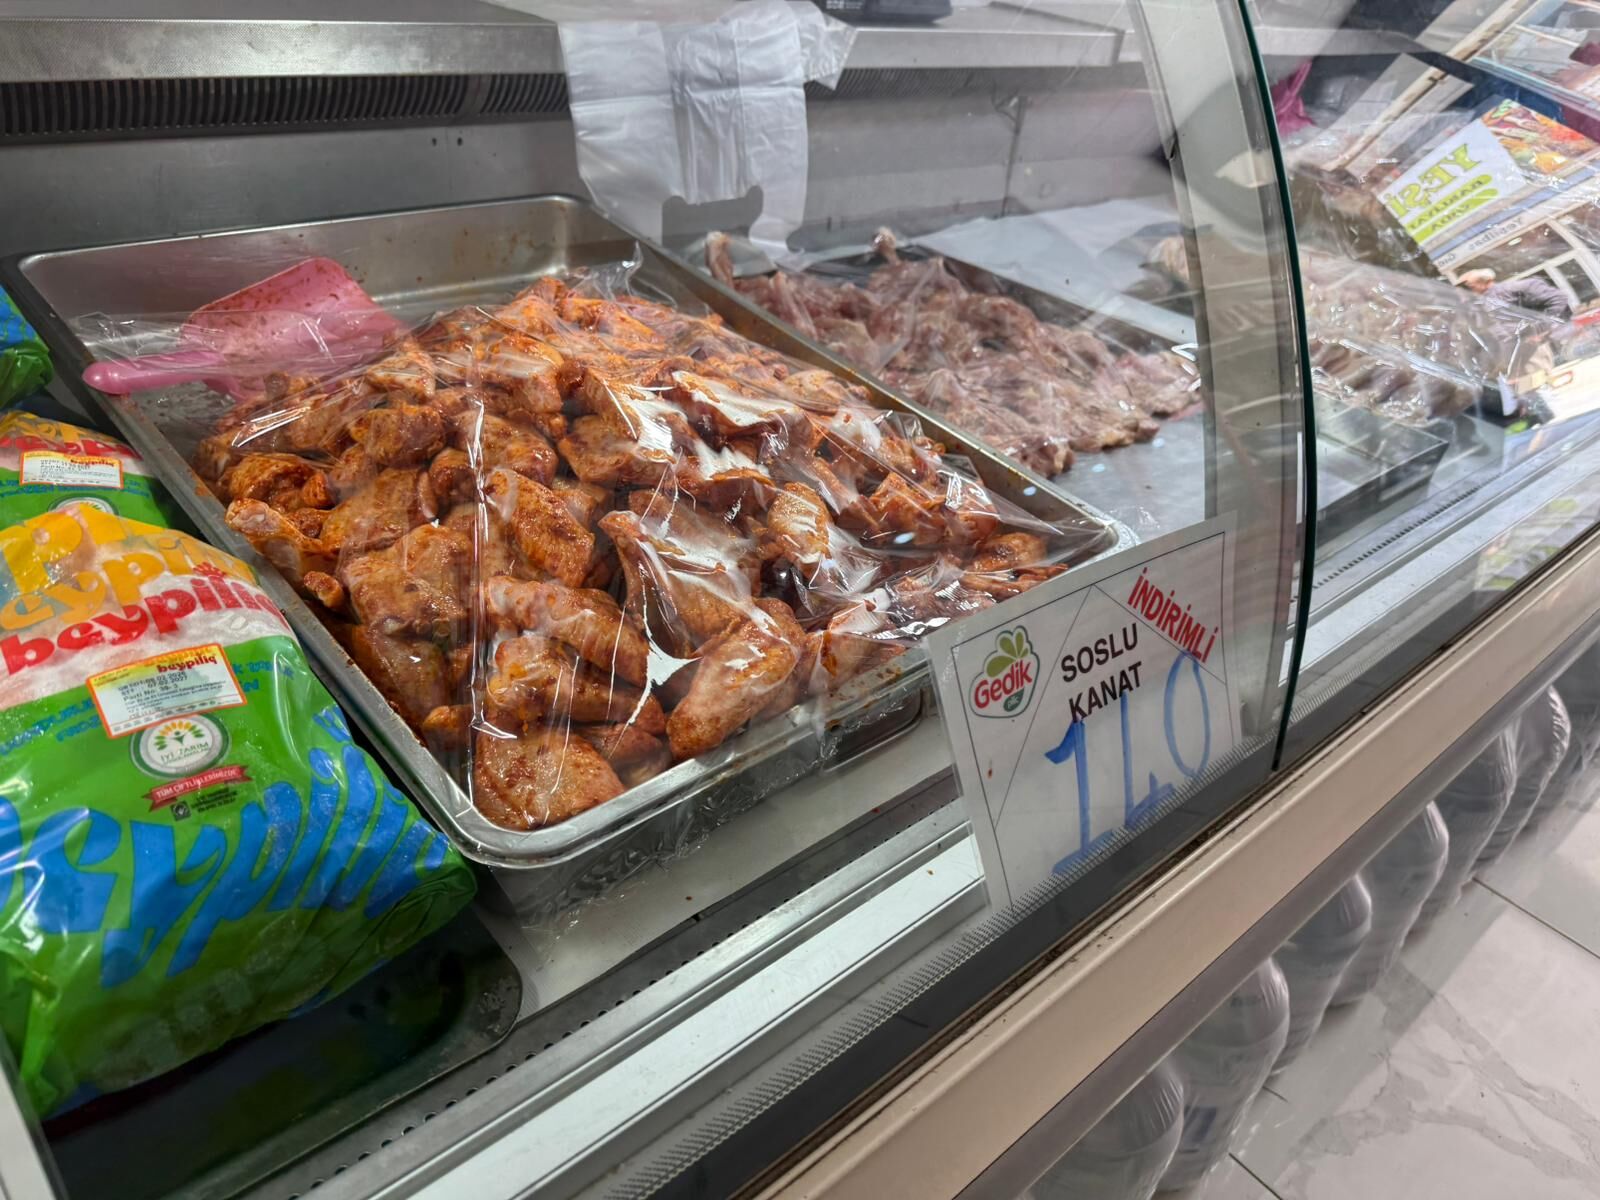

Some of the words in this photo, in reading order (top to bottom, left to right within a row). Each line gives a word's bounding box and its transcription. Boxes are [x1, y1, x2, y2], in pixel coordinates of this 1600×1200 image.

[1127, 567, 1219, 664] İNDİRİMLİ
[1061, 623, 1138, 682] SOSLU
[974, 659, 1033, 709] Gedik
[1069, 661, 1143, 722] KANAT
